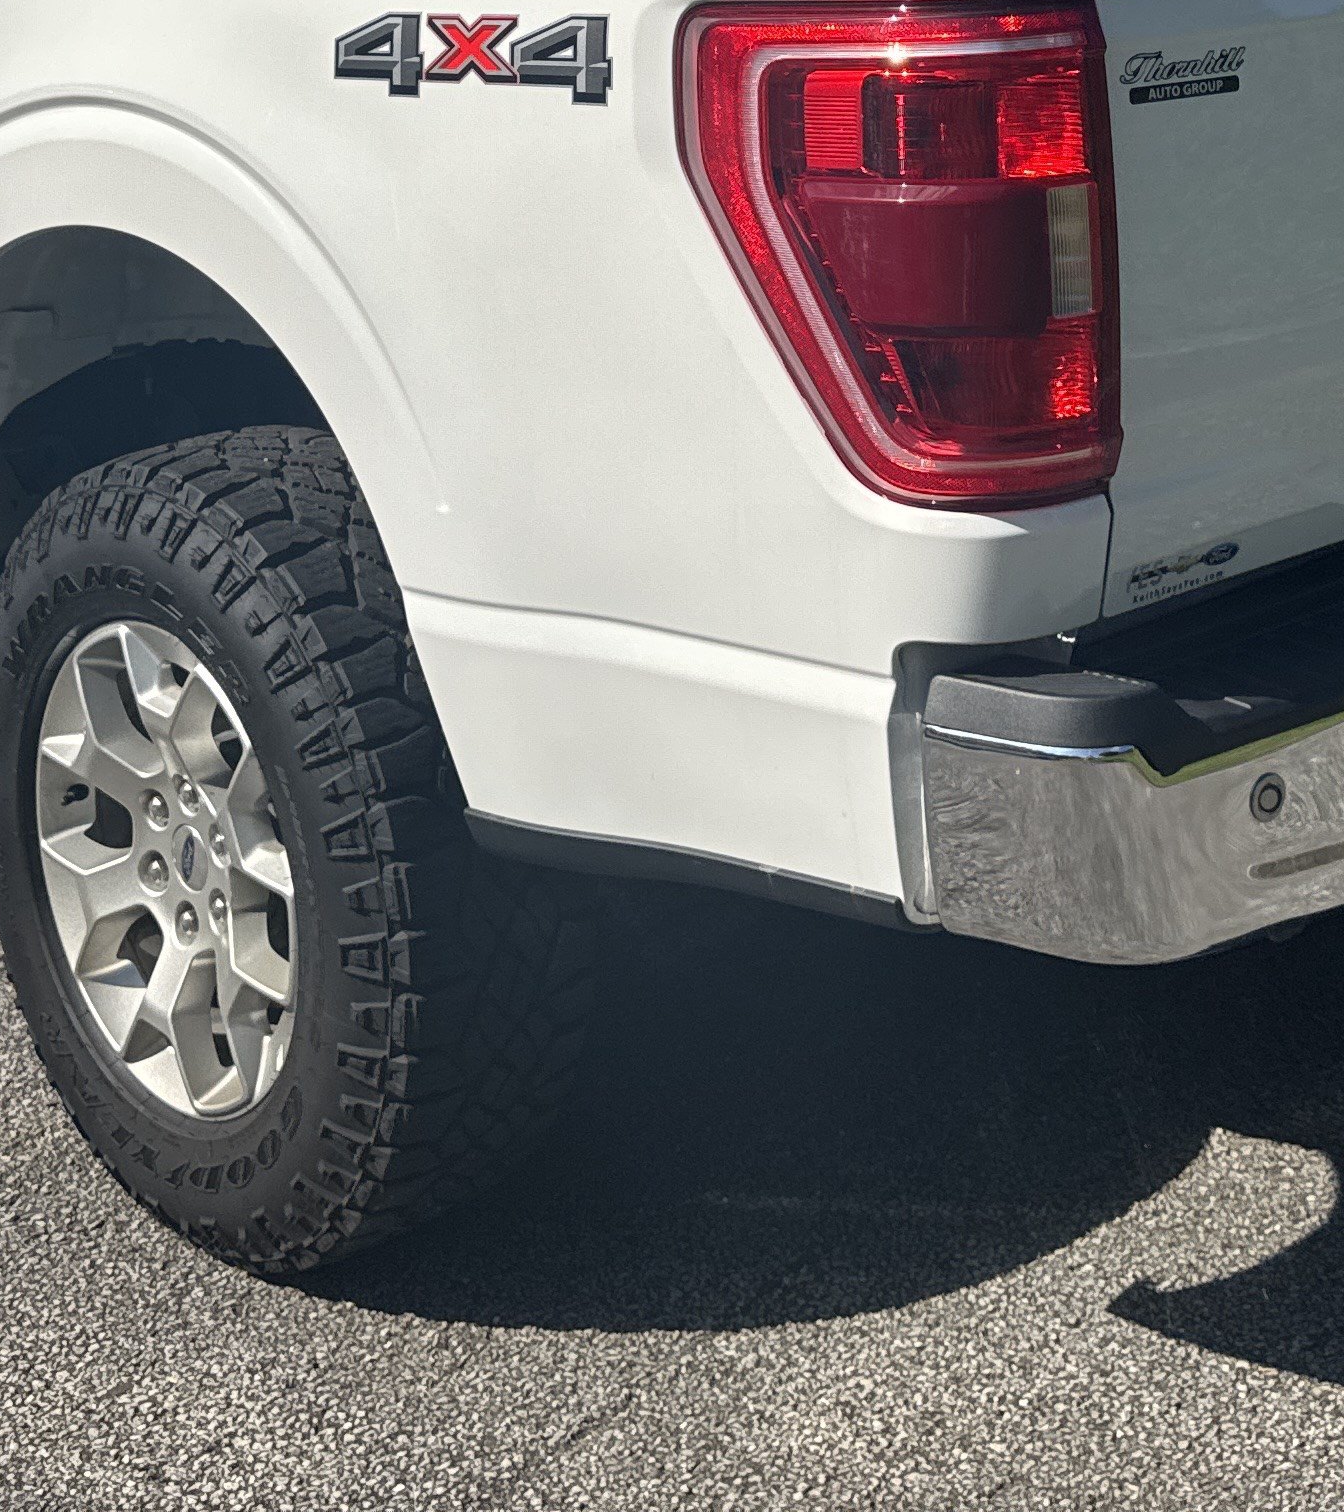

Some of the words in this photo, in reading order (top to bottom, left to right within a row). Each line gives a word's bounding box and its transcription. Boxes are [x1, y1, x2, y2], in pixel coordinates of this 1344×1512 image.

[1119, 46, 1246, 85] Thornhill
[1148, 84, 1181, 102] AUTO
[1183, 79, 1225, 96] GROUP
[1, 562, 250, 705] WRANGLER
